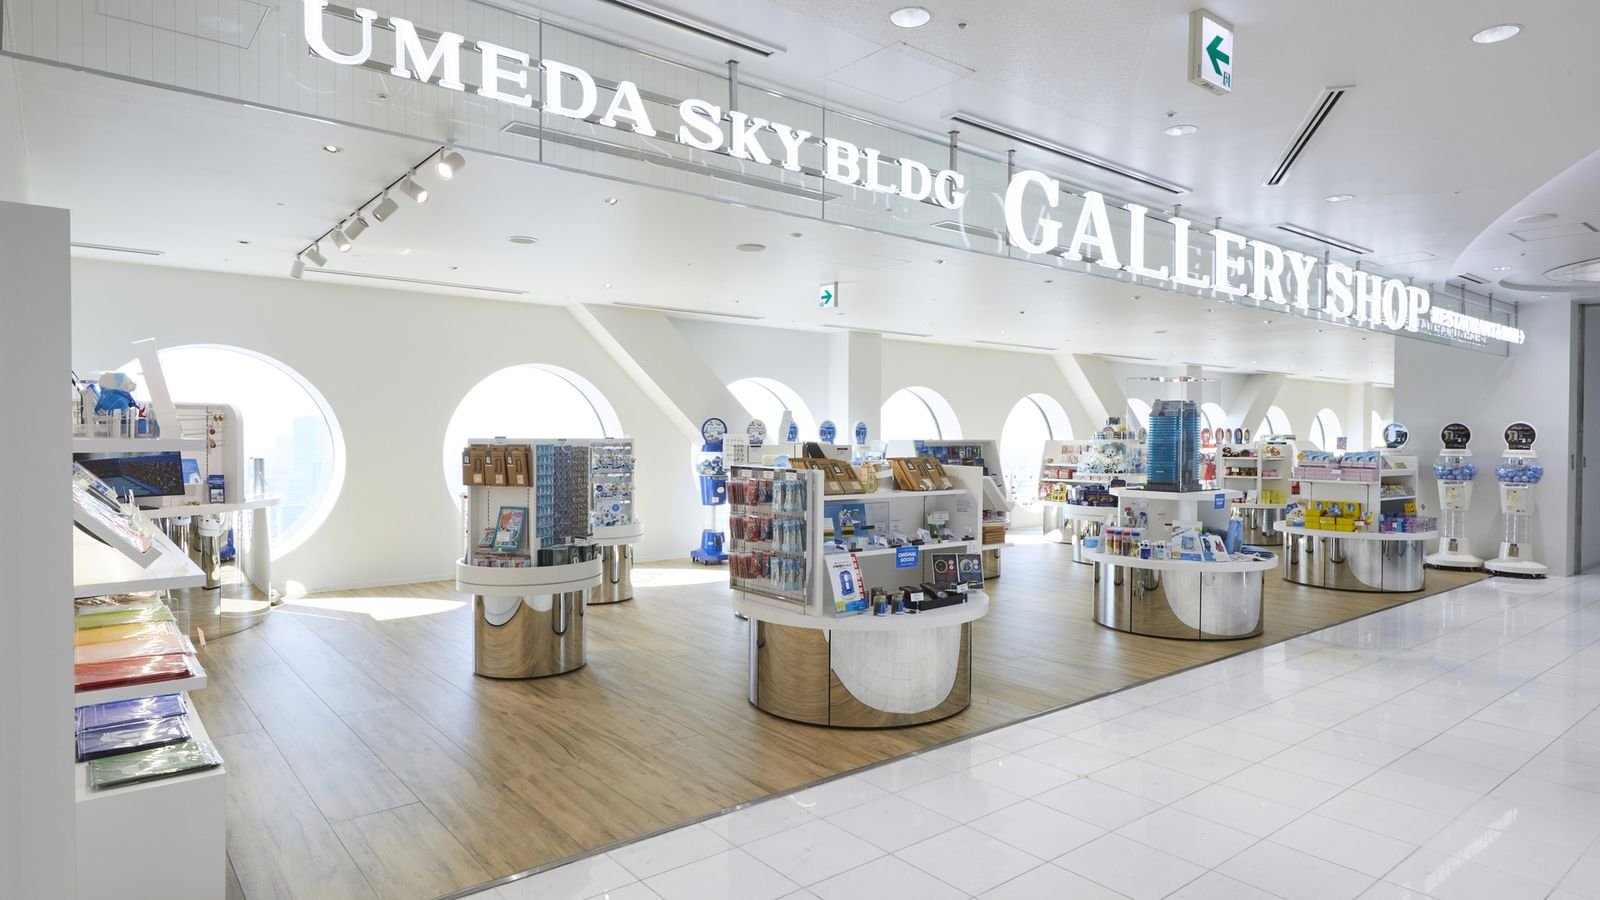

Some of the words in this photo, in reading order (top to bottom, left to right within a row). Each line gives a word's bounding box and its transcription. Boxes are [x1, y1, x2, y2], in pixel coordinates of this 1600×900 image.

[304, 0, 656, 136] UMEDA
[678, 98, 812, 172] SKY
[823, 136, 967, 210] BLDG
[1004, 170, 1318, 309] GALLERY
[1326, 262, 1431, 333] SHOP
